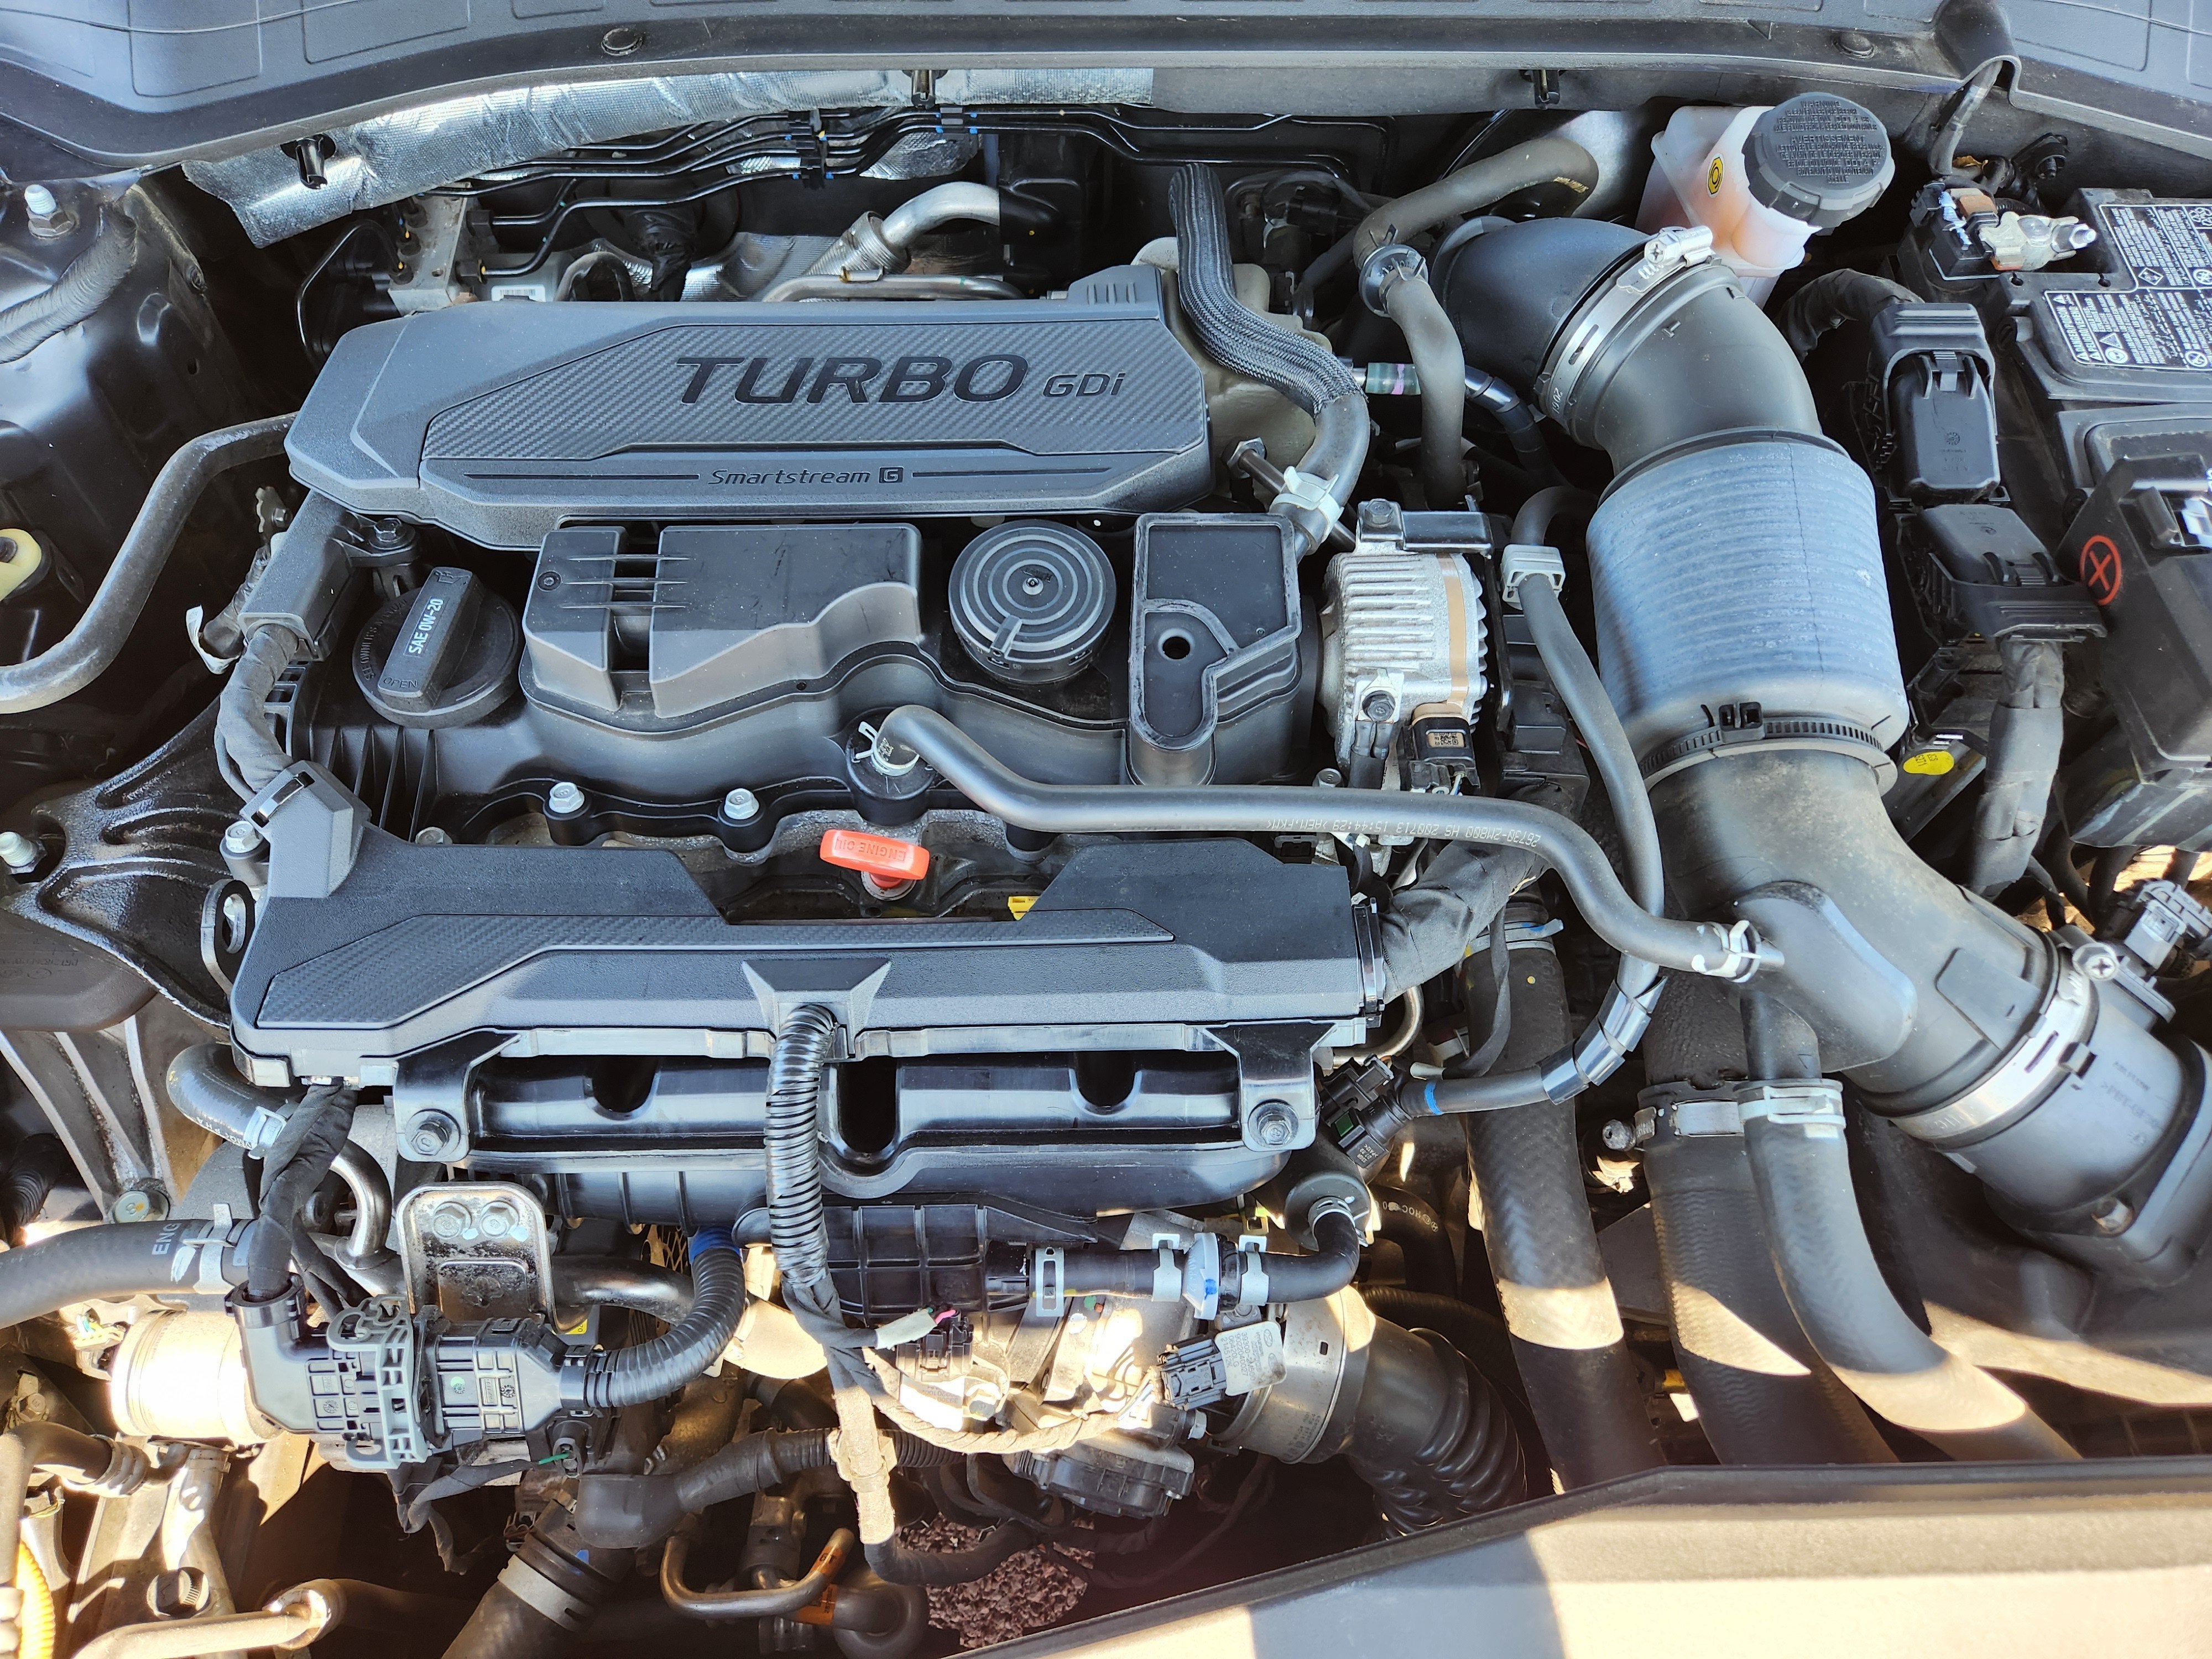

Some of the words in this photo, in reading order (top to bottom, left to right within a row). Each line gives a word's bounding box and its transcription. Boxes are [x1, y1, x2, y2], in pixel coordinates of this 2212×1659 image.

[1791, 134, 1866, 143] AVERTISSEMENT
[2056, 306, 2084, 352] DANGER/POISON
[2069, 306, 2096, 352] PELIGRO/VENENO
[676, 354, 1029, 405] TURBO
[1043, 372, 1126, 398] GDi
[708, 468, 871, 484] Smartstream
[409, 632, 428, 654] SAE
[419, 598, 444, 632] 0W-20
[383, 677, 418, 688] OPEN
[1333, 819, 1388, 833] 15:44:29
[1396, 822, 1439, 836] 200713
[1444, 825, 1459, 837] HS
[835, 836, 855, 851] OIL
[1465, 825, 1541, 848] 26730-2M800
[859, 842, 906, 862] ENGINE
[151, 1223, 182, 1255] ENG
